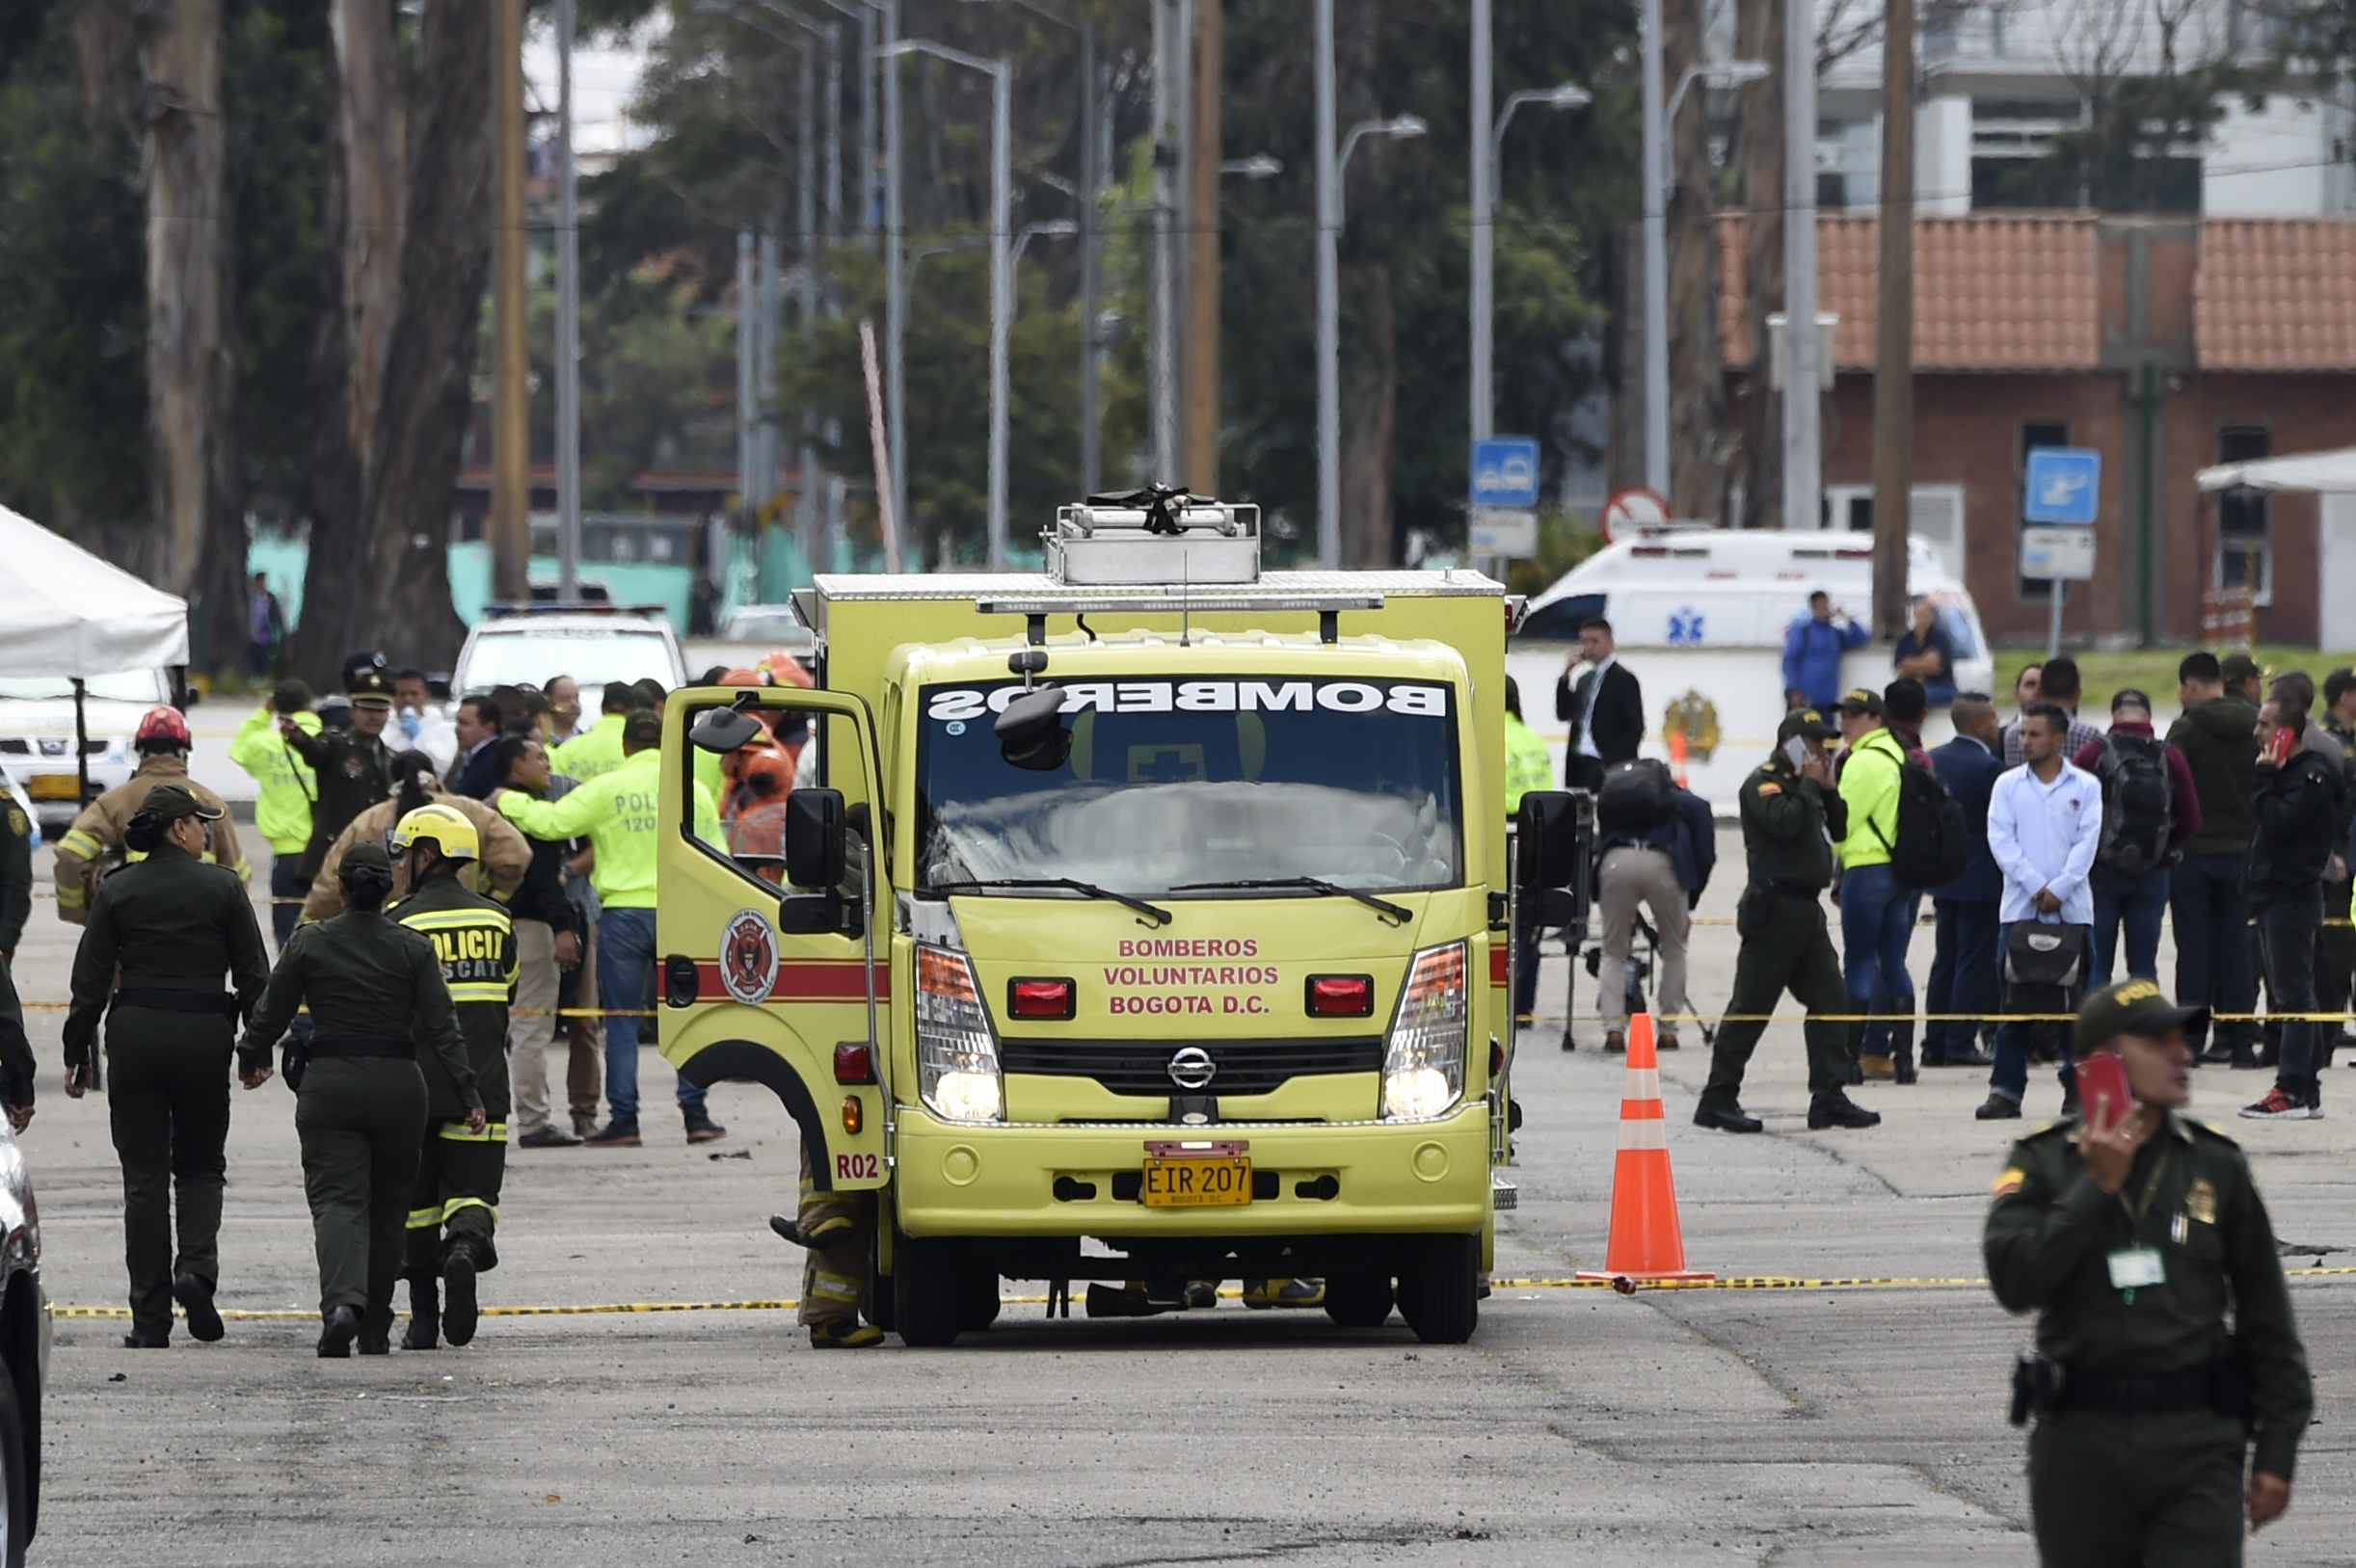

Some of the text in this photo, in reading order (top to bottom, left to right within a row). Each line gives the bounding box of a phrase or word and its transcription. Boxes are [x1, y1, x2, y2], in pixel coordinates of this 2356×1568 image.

[1118, 939, 1258, 957] BOMBEROS
[1104, 967, 1278, 985] VOLUNTARIOS
[1110, 996, 1270, 1014] BOGOTA D.C.
[837, 1154, 878, 1179] R02
[1147, 1166, 1246, 1193] EIR 207
